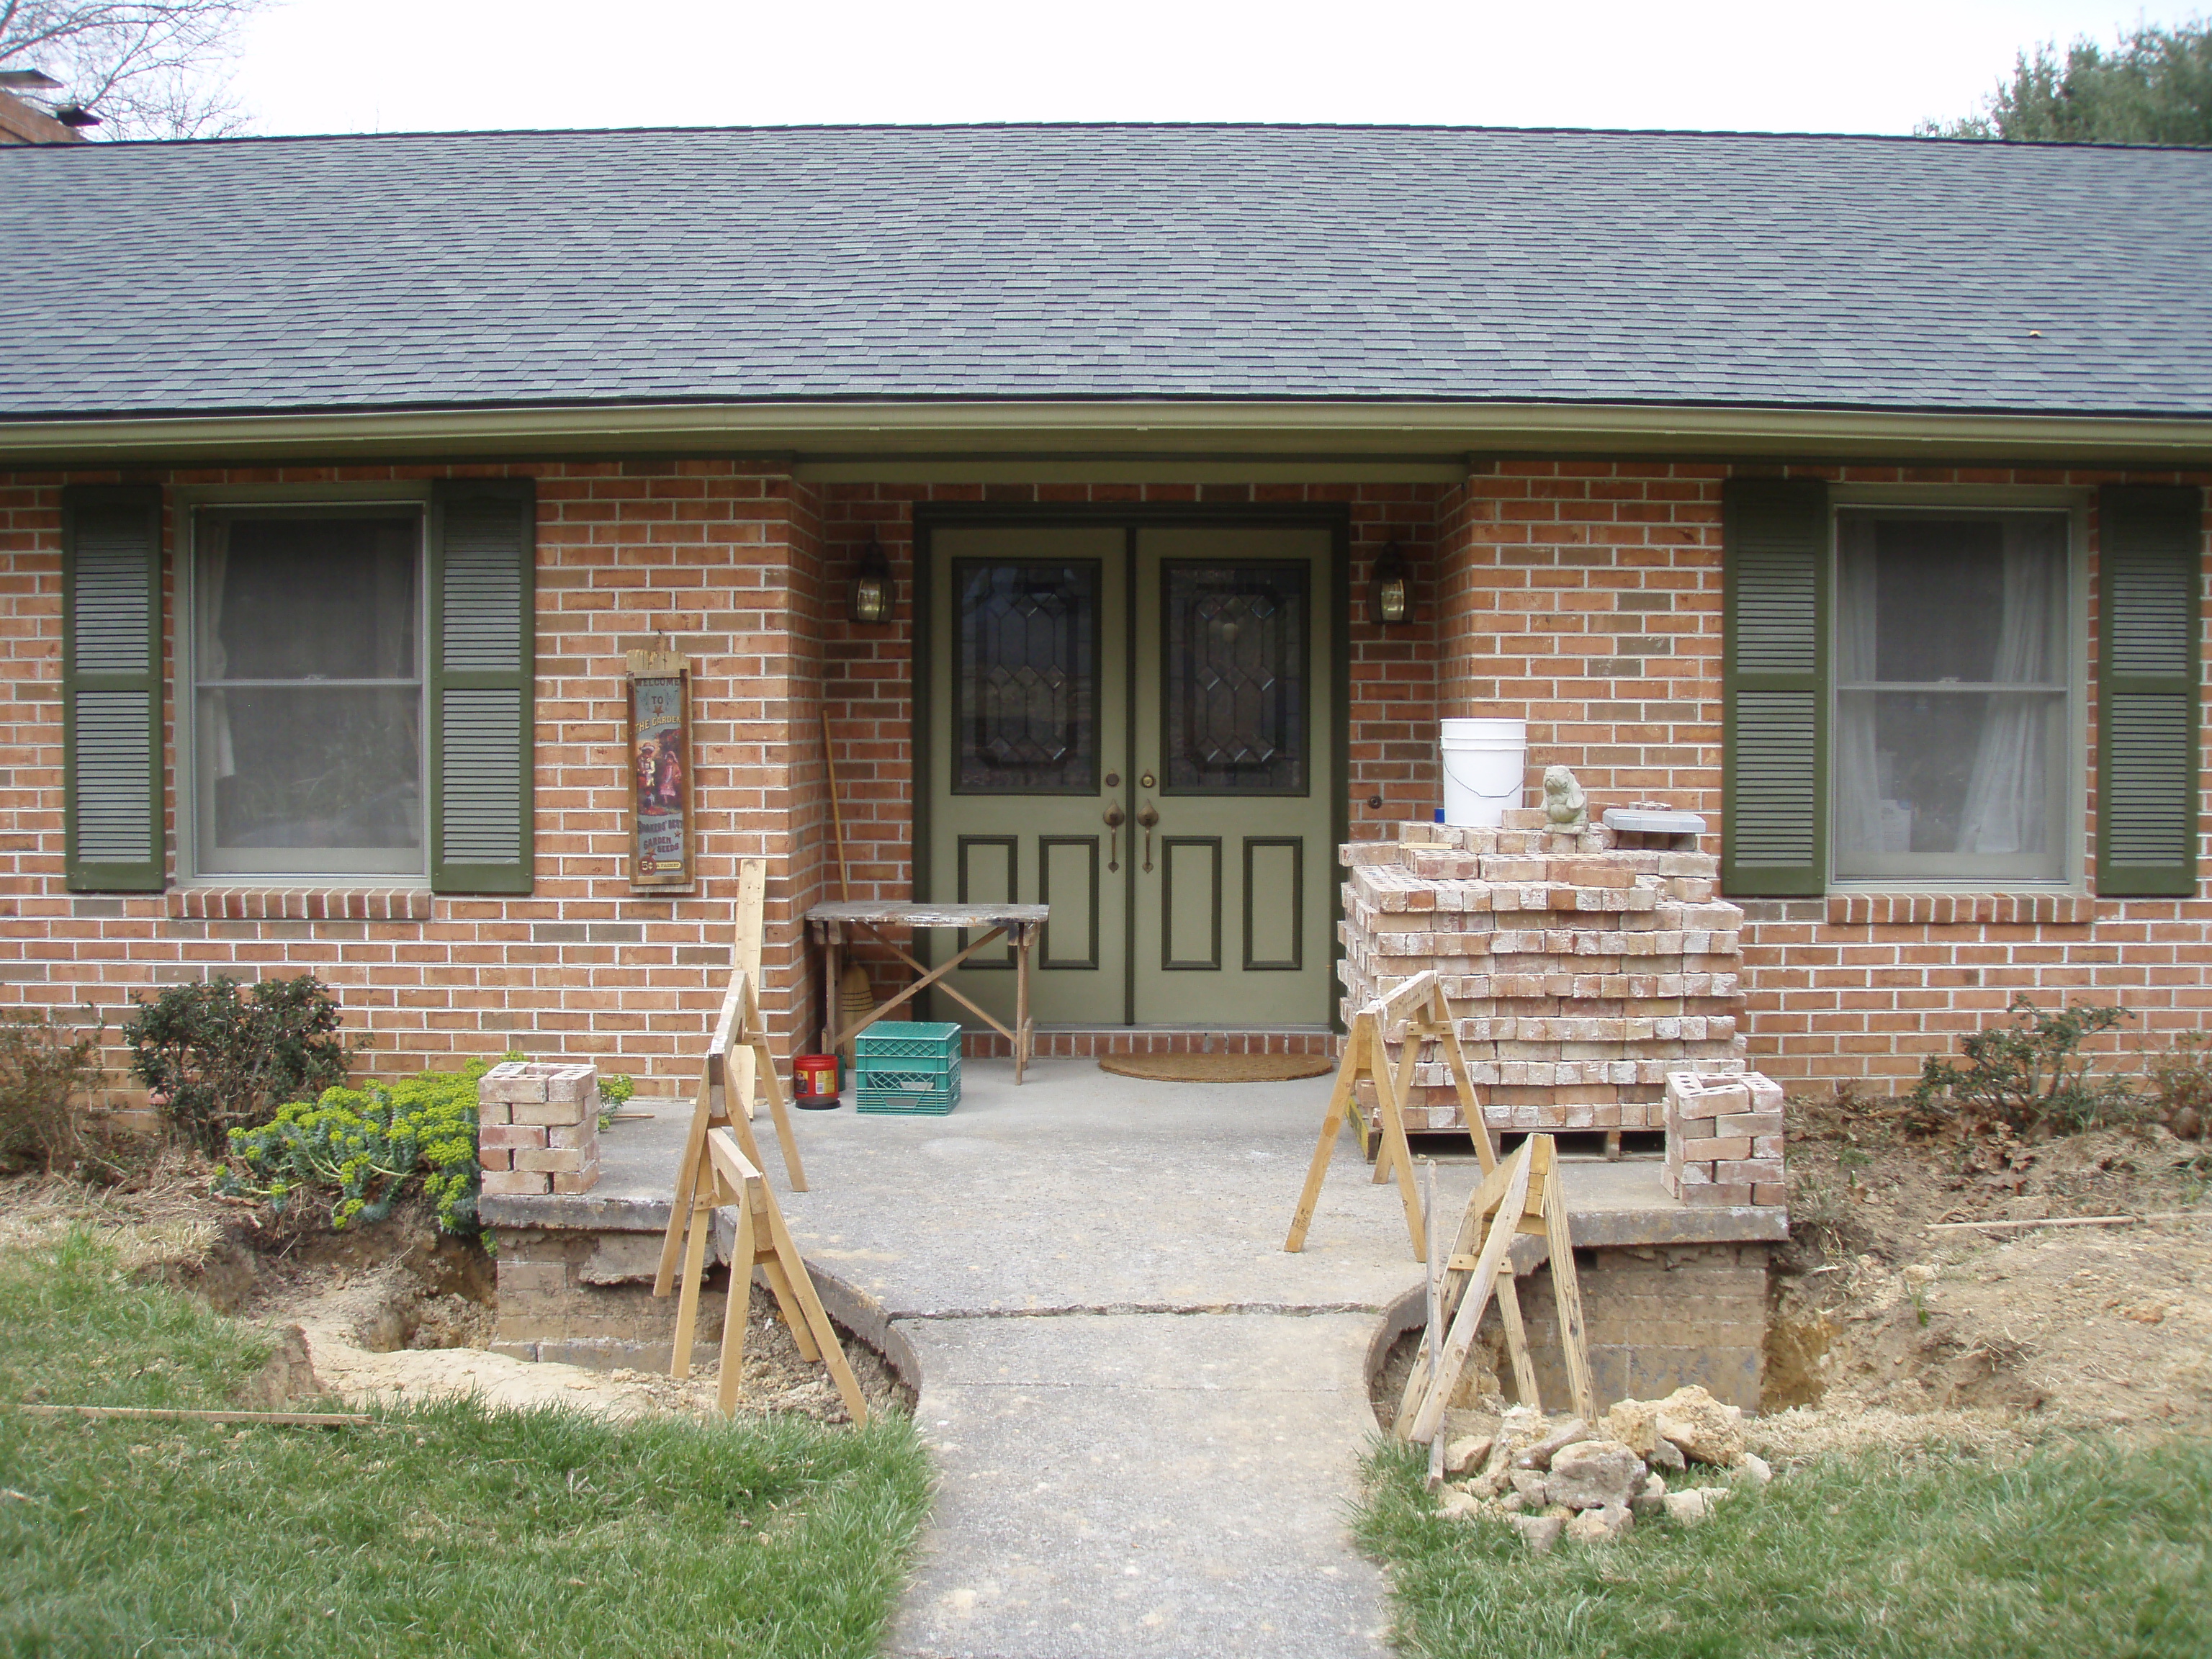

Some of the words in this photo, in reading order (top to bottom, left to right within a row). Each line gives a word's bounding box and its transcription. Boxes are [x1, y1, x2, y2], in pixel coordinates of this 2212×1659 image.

[635, 720, 650, 733] THE
[644, 837, 671, 850] GARDEN
[657, 842, 679, 853] SEEDS
